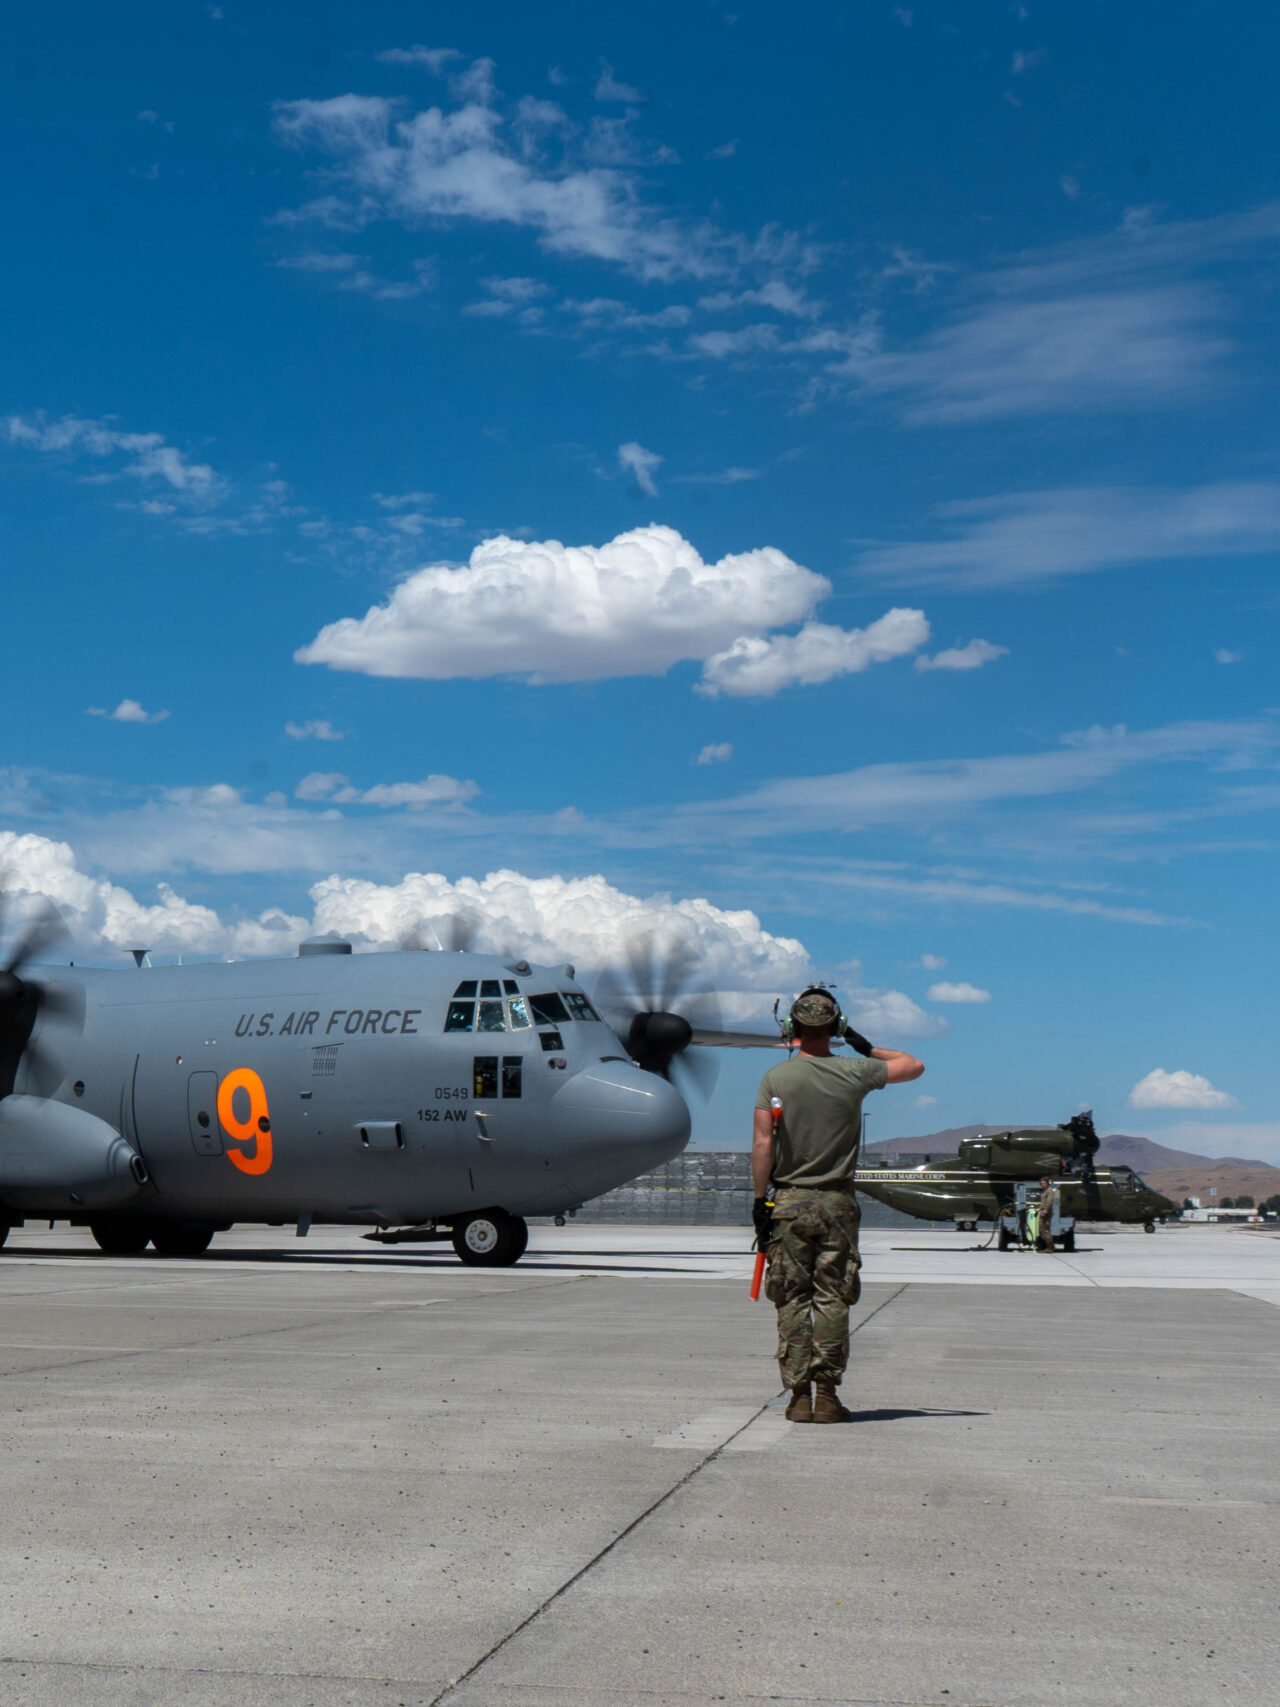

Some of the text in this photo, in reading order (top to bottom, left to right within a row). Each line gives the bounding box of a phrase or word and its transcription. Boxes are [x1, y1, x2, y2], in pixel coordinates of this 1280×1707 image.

[234, 1009, 422, 1038] U.S. AIR FORCE
[434, 1087, 468, 1100] 0549
[217, 1067, 273, 1176] 9
[417, 1109, 468, 1121] 152 AW
